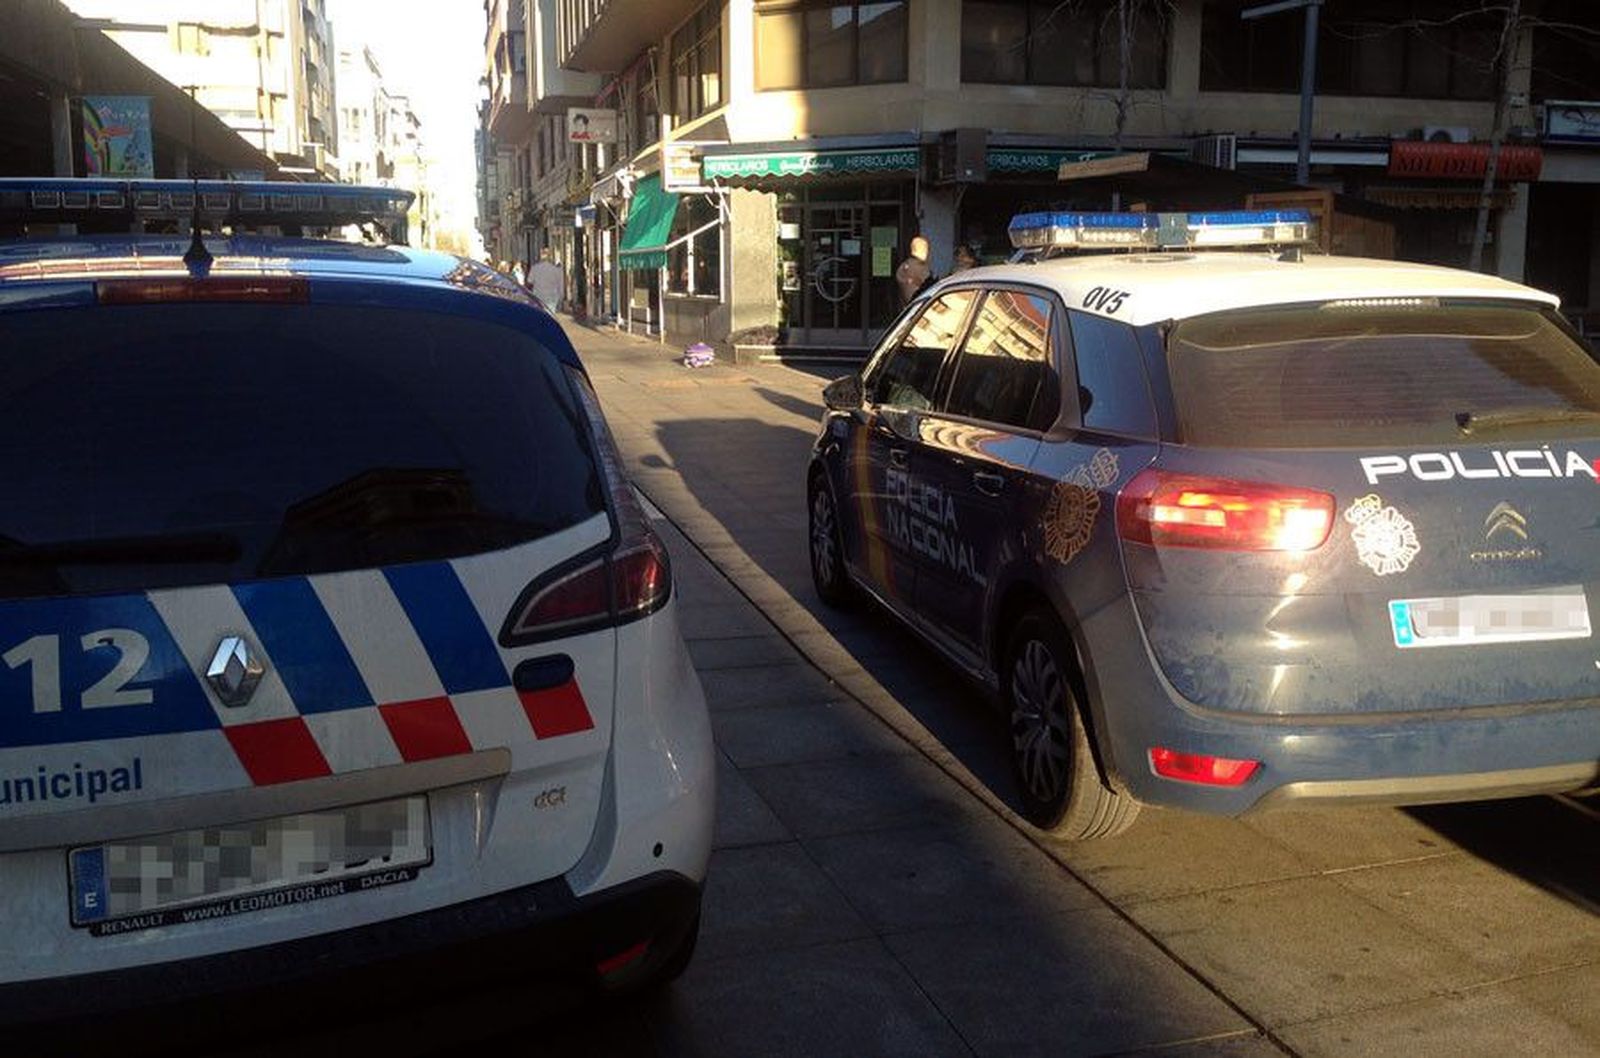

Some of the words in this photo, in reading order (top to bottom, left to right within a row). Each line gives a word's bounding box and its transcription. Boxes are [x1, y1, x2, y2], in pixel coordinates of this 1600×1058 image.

[846, 153, 916, 168] HERBOLARIOS
[987, 153, 1049, 168] ERBOLARIOS
[1360, 444, 1598, 485] POLICÍA
[886, 503, 988, 587] NACIONAL
[2, 628, 154, 714] 12
[101, 913, 165, 935] RENAULT
[360, 869, 410, 889] DACIA
